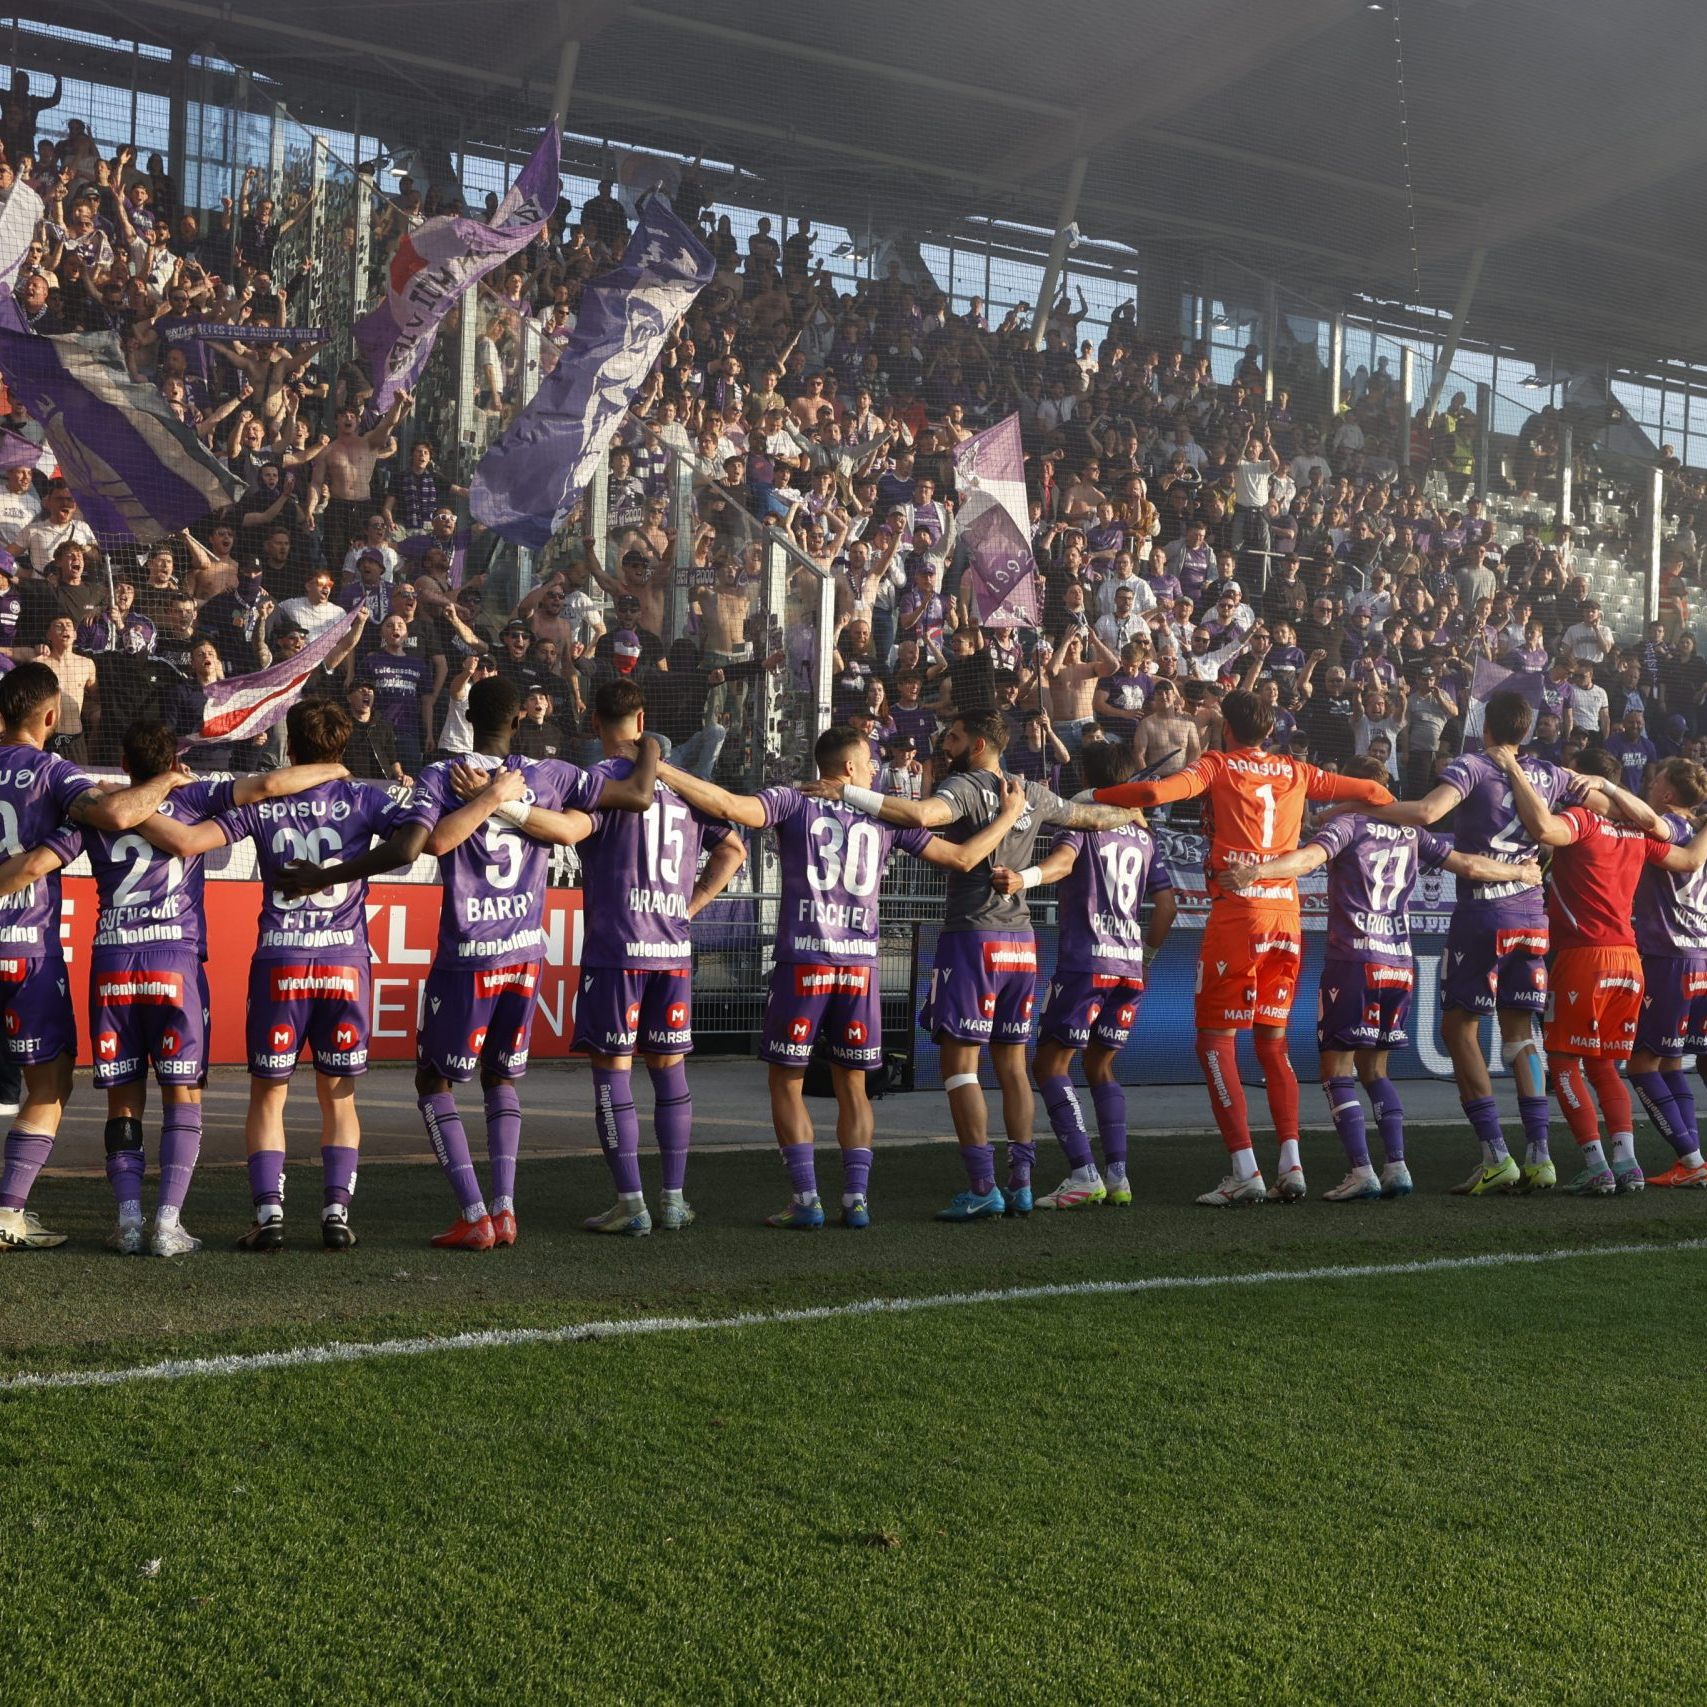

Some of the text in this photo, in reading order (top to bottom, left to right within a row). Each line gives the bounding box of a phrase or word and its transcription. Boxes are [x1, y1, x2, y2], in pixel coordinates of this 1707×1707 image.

[249, 328, 292, 338] AUSTRIA
[1255, 783, 1276, 848] 1
[643, 802, 687, 885] 15
[485, 816, 524, 890] 5
[806, 816, 881, 897] 30
[1100, 841, 1143, 915] 18
[1278, 988, 1287, 1000] M
[1514, 991, 1546, 1003] MARS
[672, 1009, 685, 1021] M
[1121, 1010, 1132, 1021] M
[793, 1023, 807, 1036] M
[848, 1027, 862, 1040] M
[274, 1032, 289, 1045] M
[337, 1030, 351, 1044] M
[1570, 1034, 1601, 1048] MARS
[100, 1040, 116, 1053] M
[94, 1057, 140, 1079] ARSBET
[446, 1053, 478, 1071] MAR
[600, 1084, 618, 1149] wienholding
